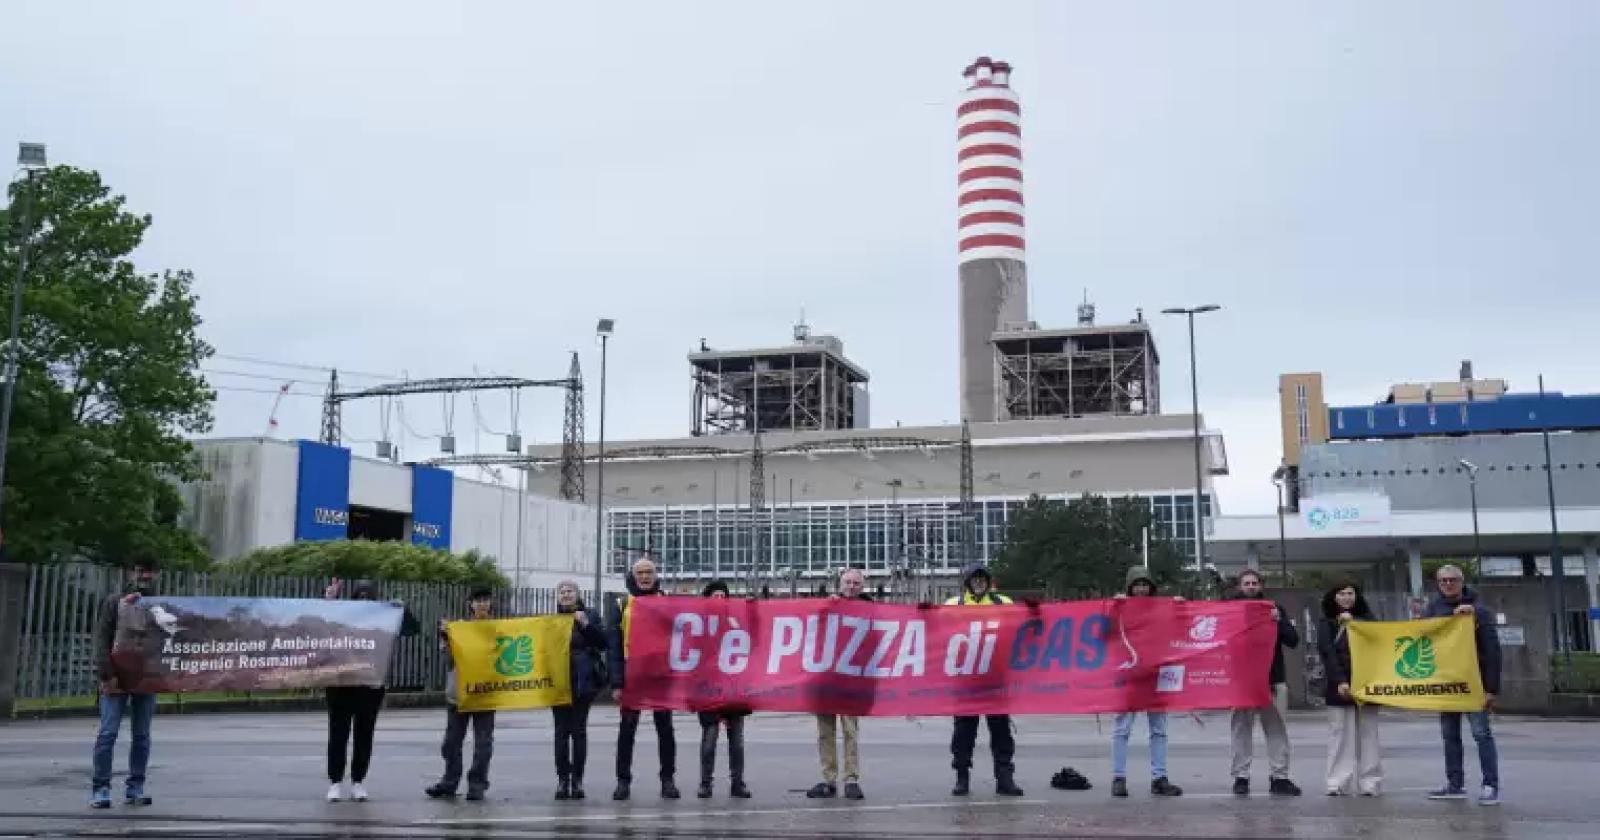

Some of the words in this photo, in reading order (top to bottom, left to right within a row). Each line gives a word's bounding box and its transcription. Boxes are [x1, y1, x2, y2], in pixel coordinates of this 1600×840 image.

[161, 638, 266, 654] Associazione
[271, 635, 376, 650] Ambientalista
[669, 612, 750, 674] C'è
[766, 614, 926, 677] PUZZA
[944, 621, 1000, 676] di
[1008, 612, 1112, 672] GAS
[161, 656, 233, 674] "Eugenio
[1364, 682, 1472, 696] LEGAMBIENTE
